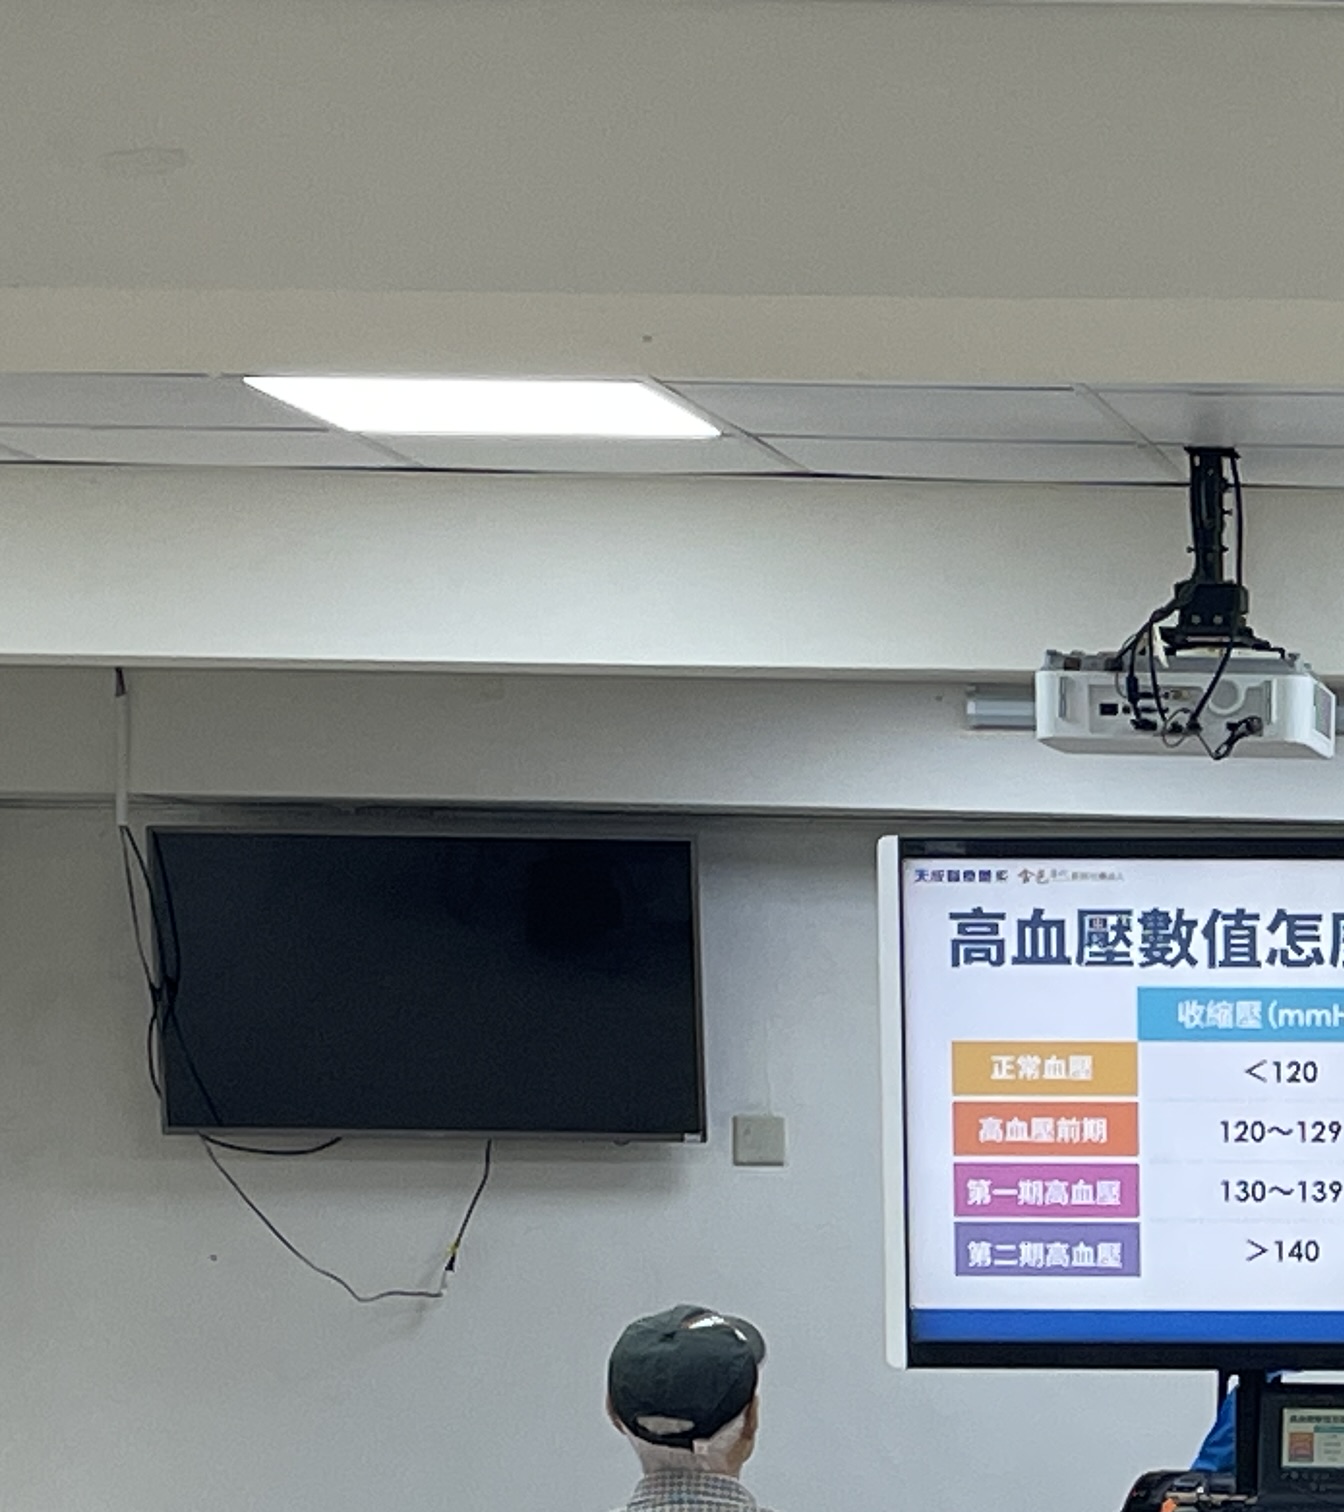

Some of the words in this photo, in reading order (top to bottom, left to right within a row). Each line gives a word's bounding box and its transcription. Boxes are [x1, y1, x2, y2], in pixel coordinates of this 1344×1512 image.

[990, 1055, 1094, 1081] 正常血壓
[977, 1116, 1108, 1144] 高血壓前期
[966, 1178, 1122, 1206] 第一期高血壓
[967, 1240, 1123, 1269] 第二期高血壓
